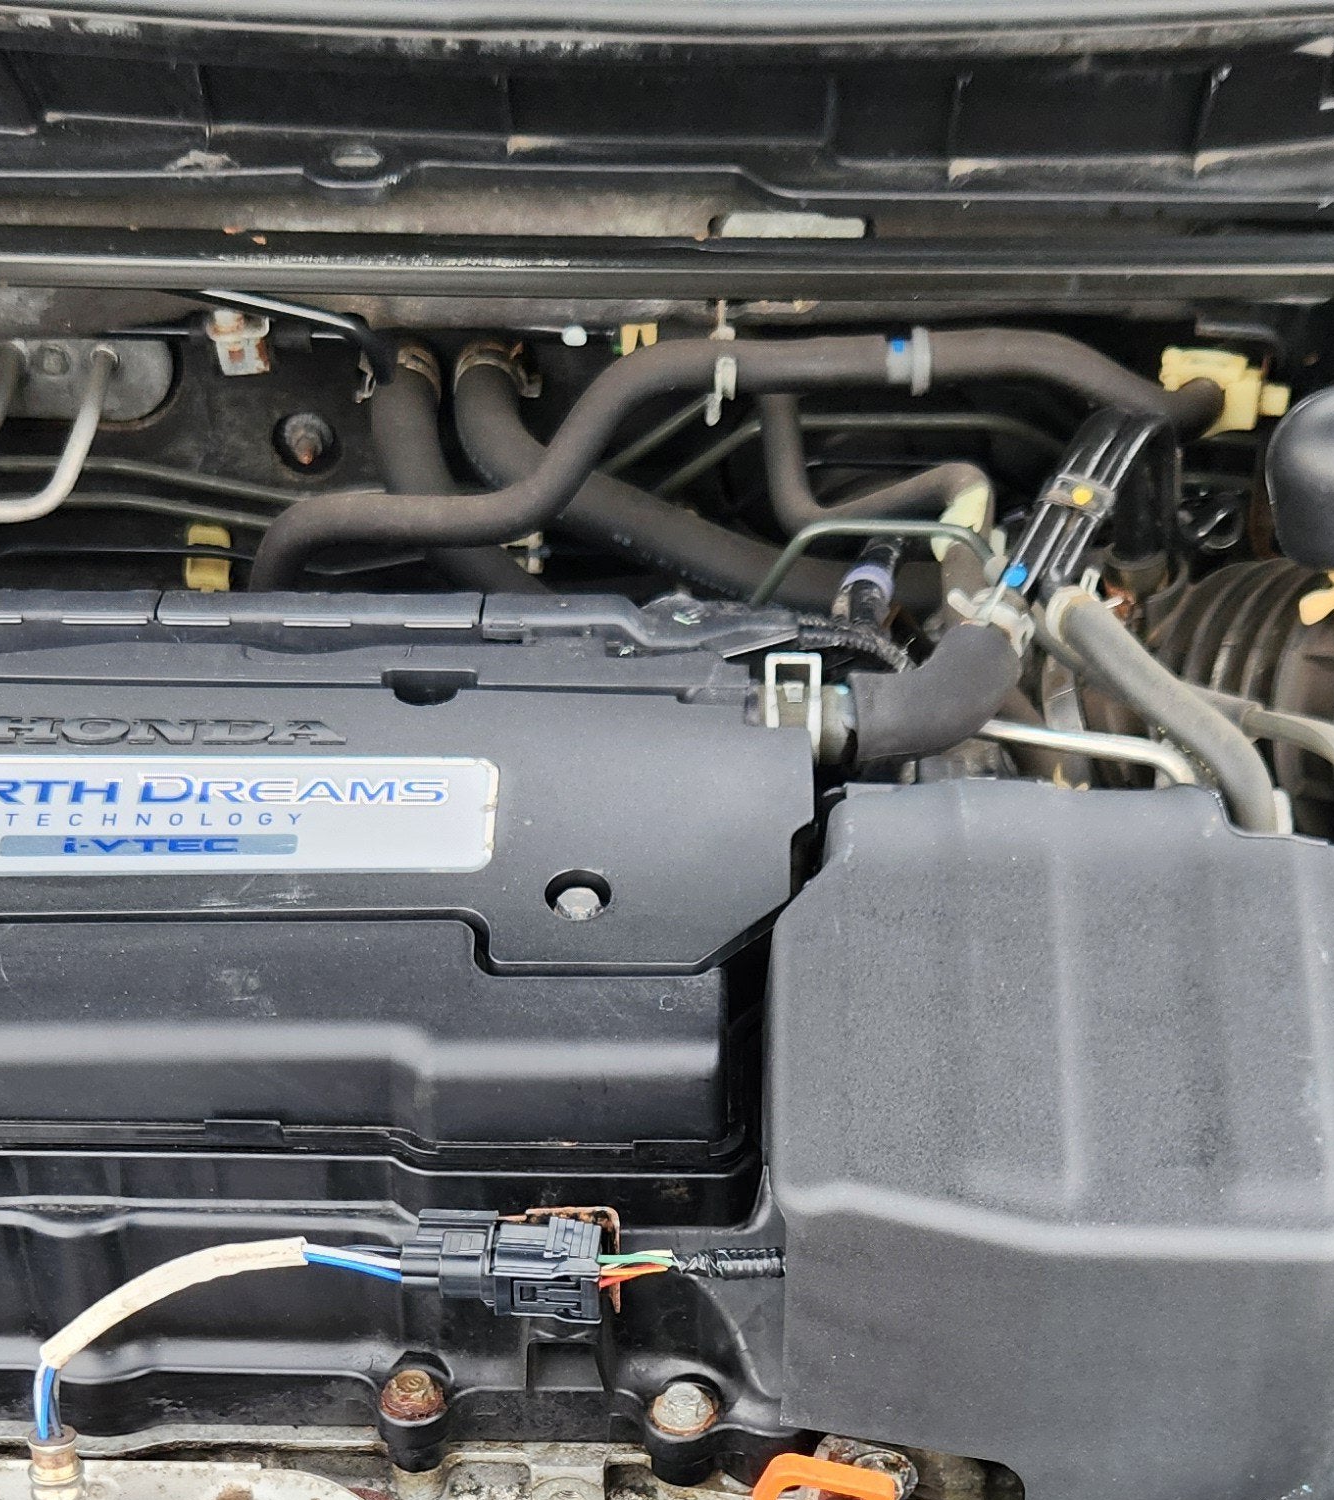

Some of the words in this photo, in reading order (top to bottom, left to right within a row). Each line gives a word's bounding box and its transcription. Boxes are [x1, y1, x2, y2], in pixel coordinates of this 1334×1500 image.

[140, 774, 448, 805] DREAMS
[6, 812, 305, 828] TECHNOLOGY
[63, 836, 239, 855] i-VTEC
